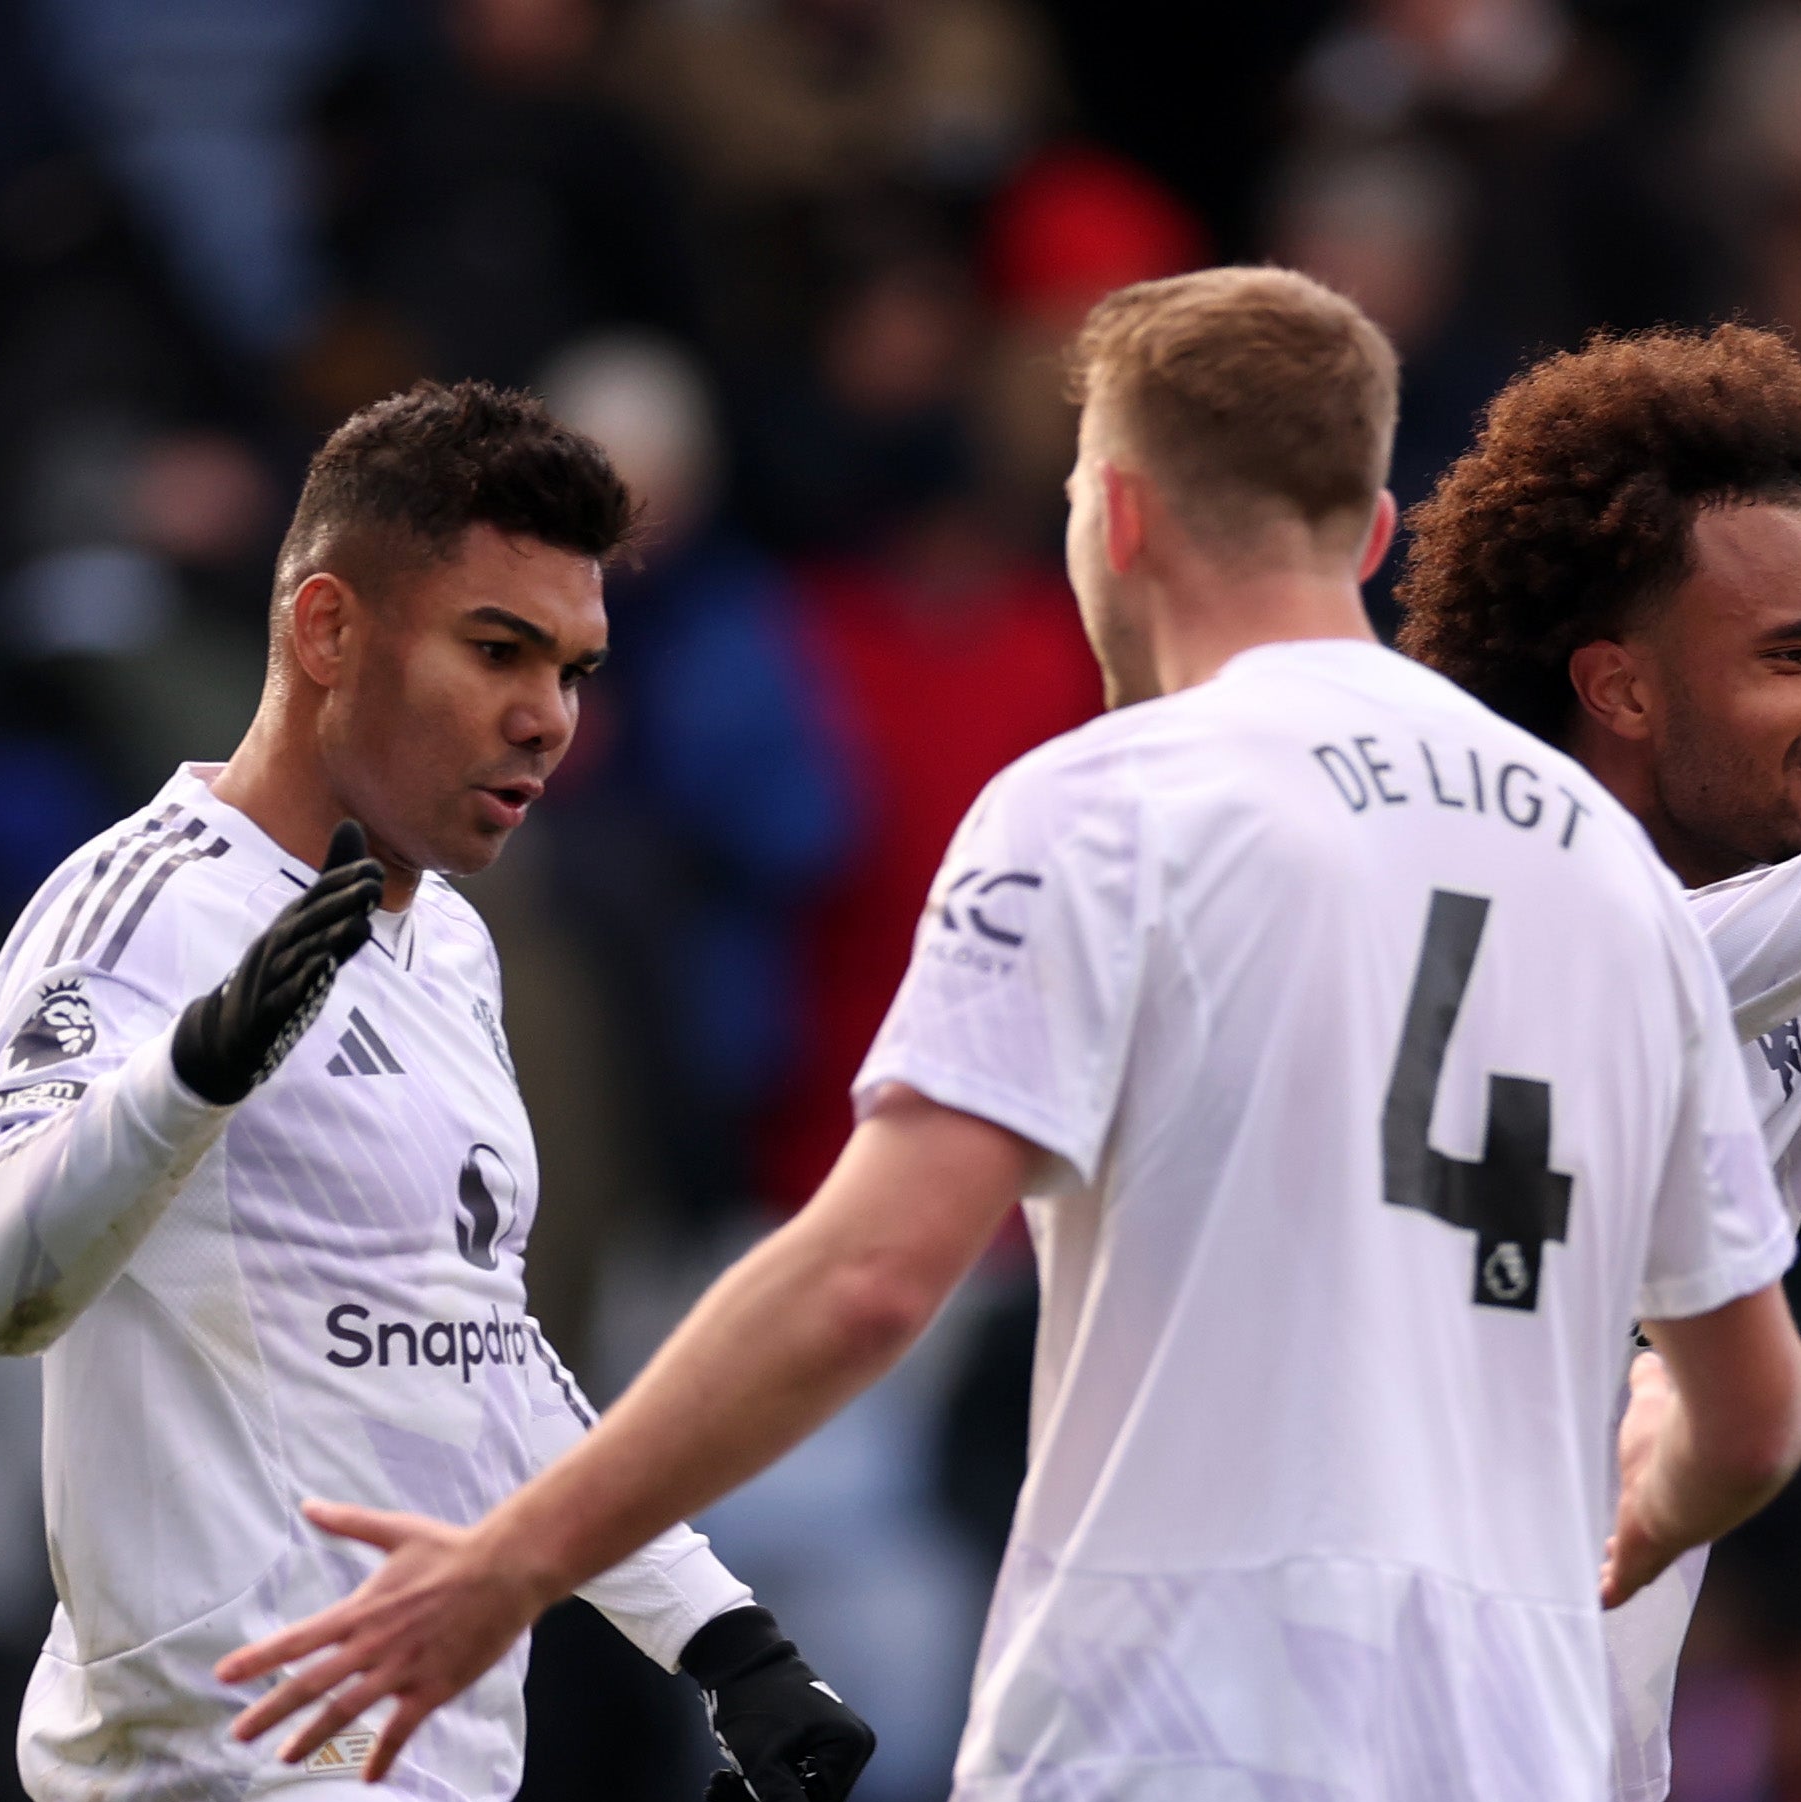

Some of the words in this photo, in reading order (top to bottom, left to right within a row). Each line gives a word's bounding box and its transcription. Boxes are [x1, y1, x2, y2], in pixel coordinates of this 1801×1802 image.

[1309, 735, 1408, 813] DE
[1418, 739, 1592, 850] LIGT
[1382, 886, 1574, 1313] 4
